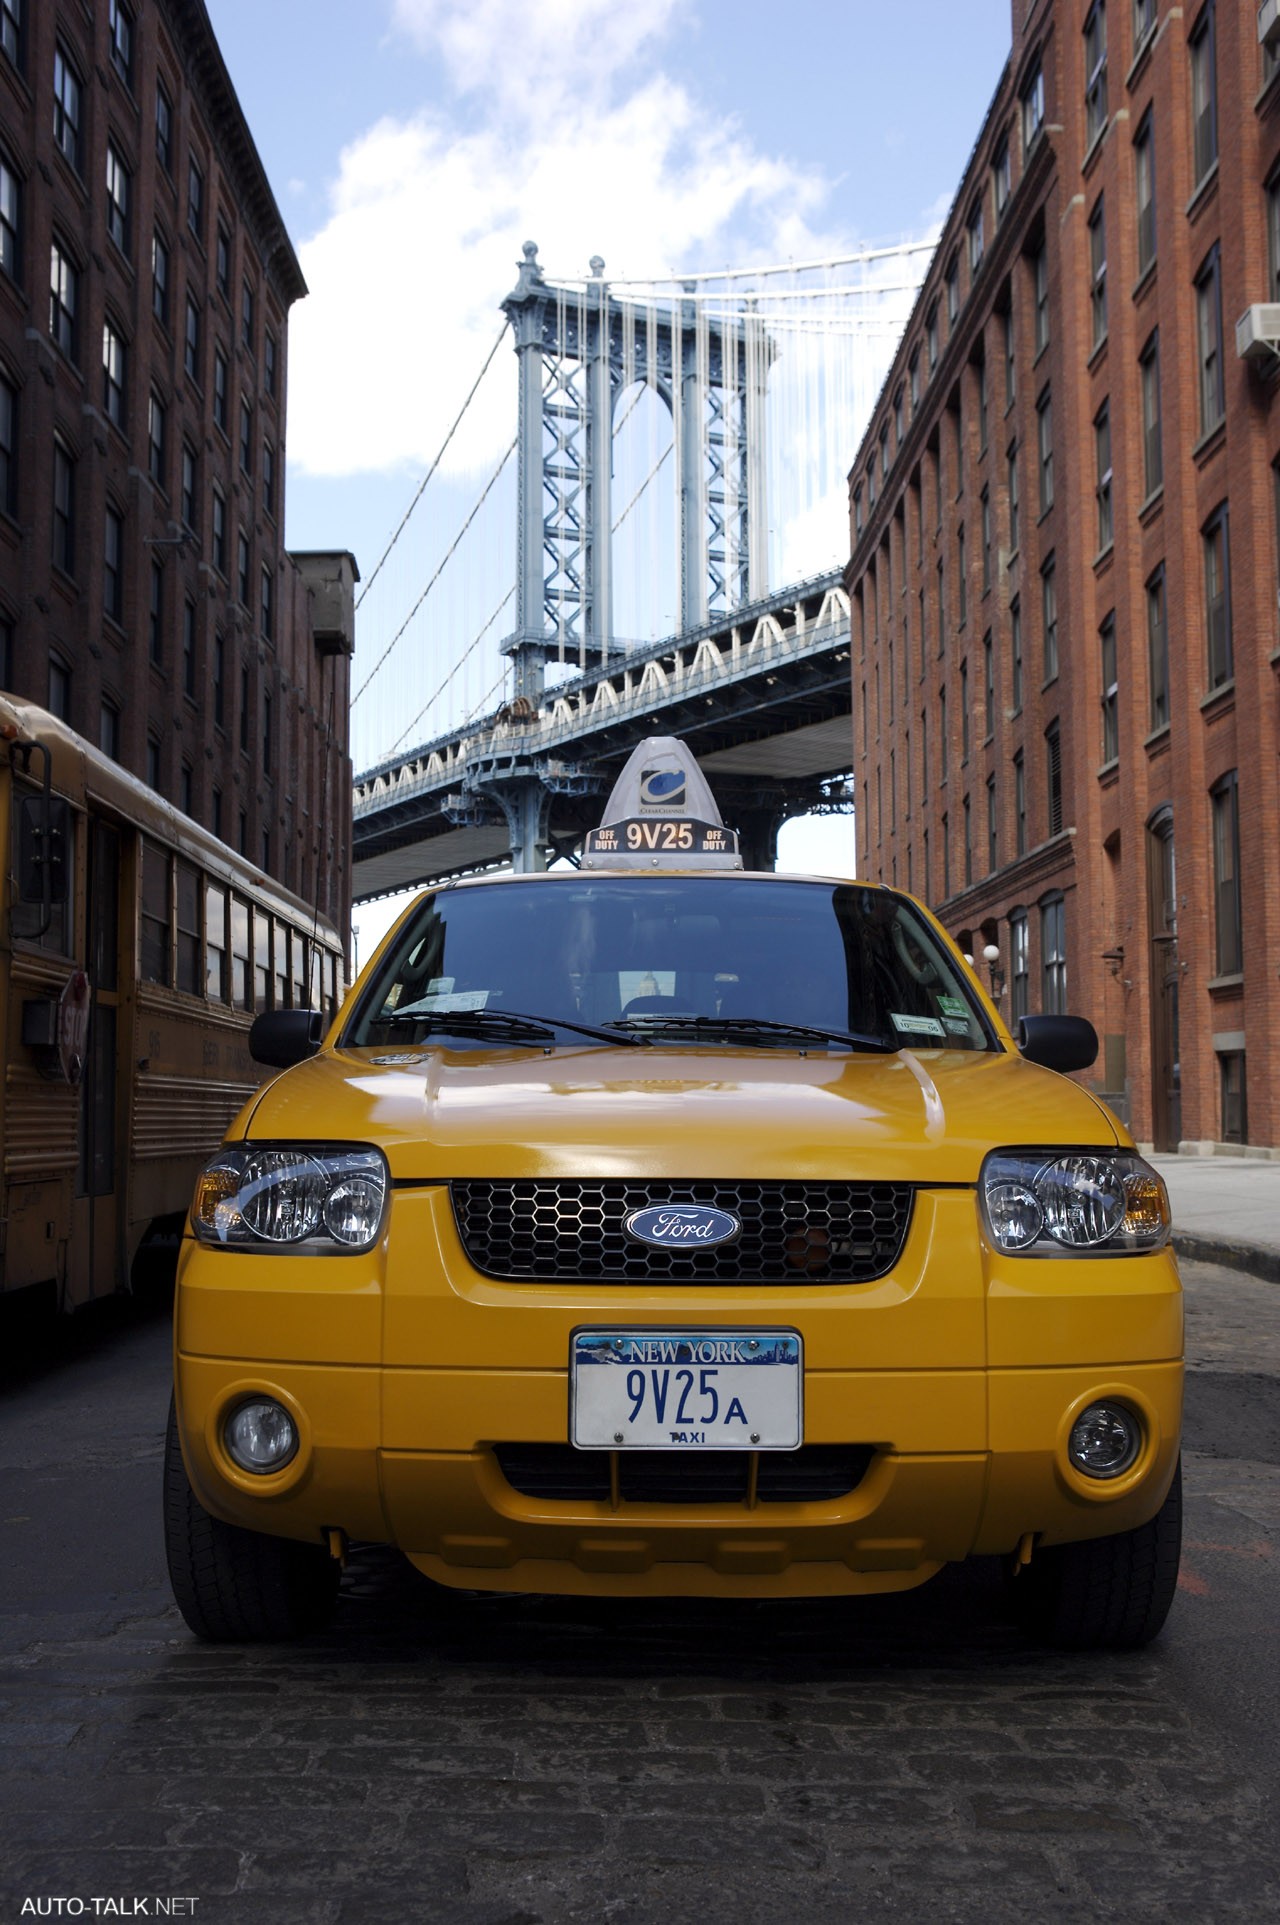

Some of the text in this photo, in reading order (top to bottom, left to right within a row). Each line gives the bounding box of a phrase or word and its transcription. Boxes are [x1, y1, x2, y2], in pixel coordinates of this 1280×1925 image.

[599, 830, 615, 839] OFF
[626, 823, 693, 850] 9V25
[706, 830, 722, 839] OFF
[595, 840, 618, 850] DUTY
[703, 840, 726, 850] DUTY
[652, 1212, 714, 1238] Ford
[628, 1341, 746, 1363] NEW YORK
[669, 1431, 705, 1444] TAXI
